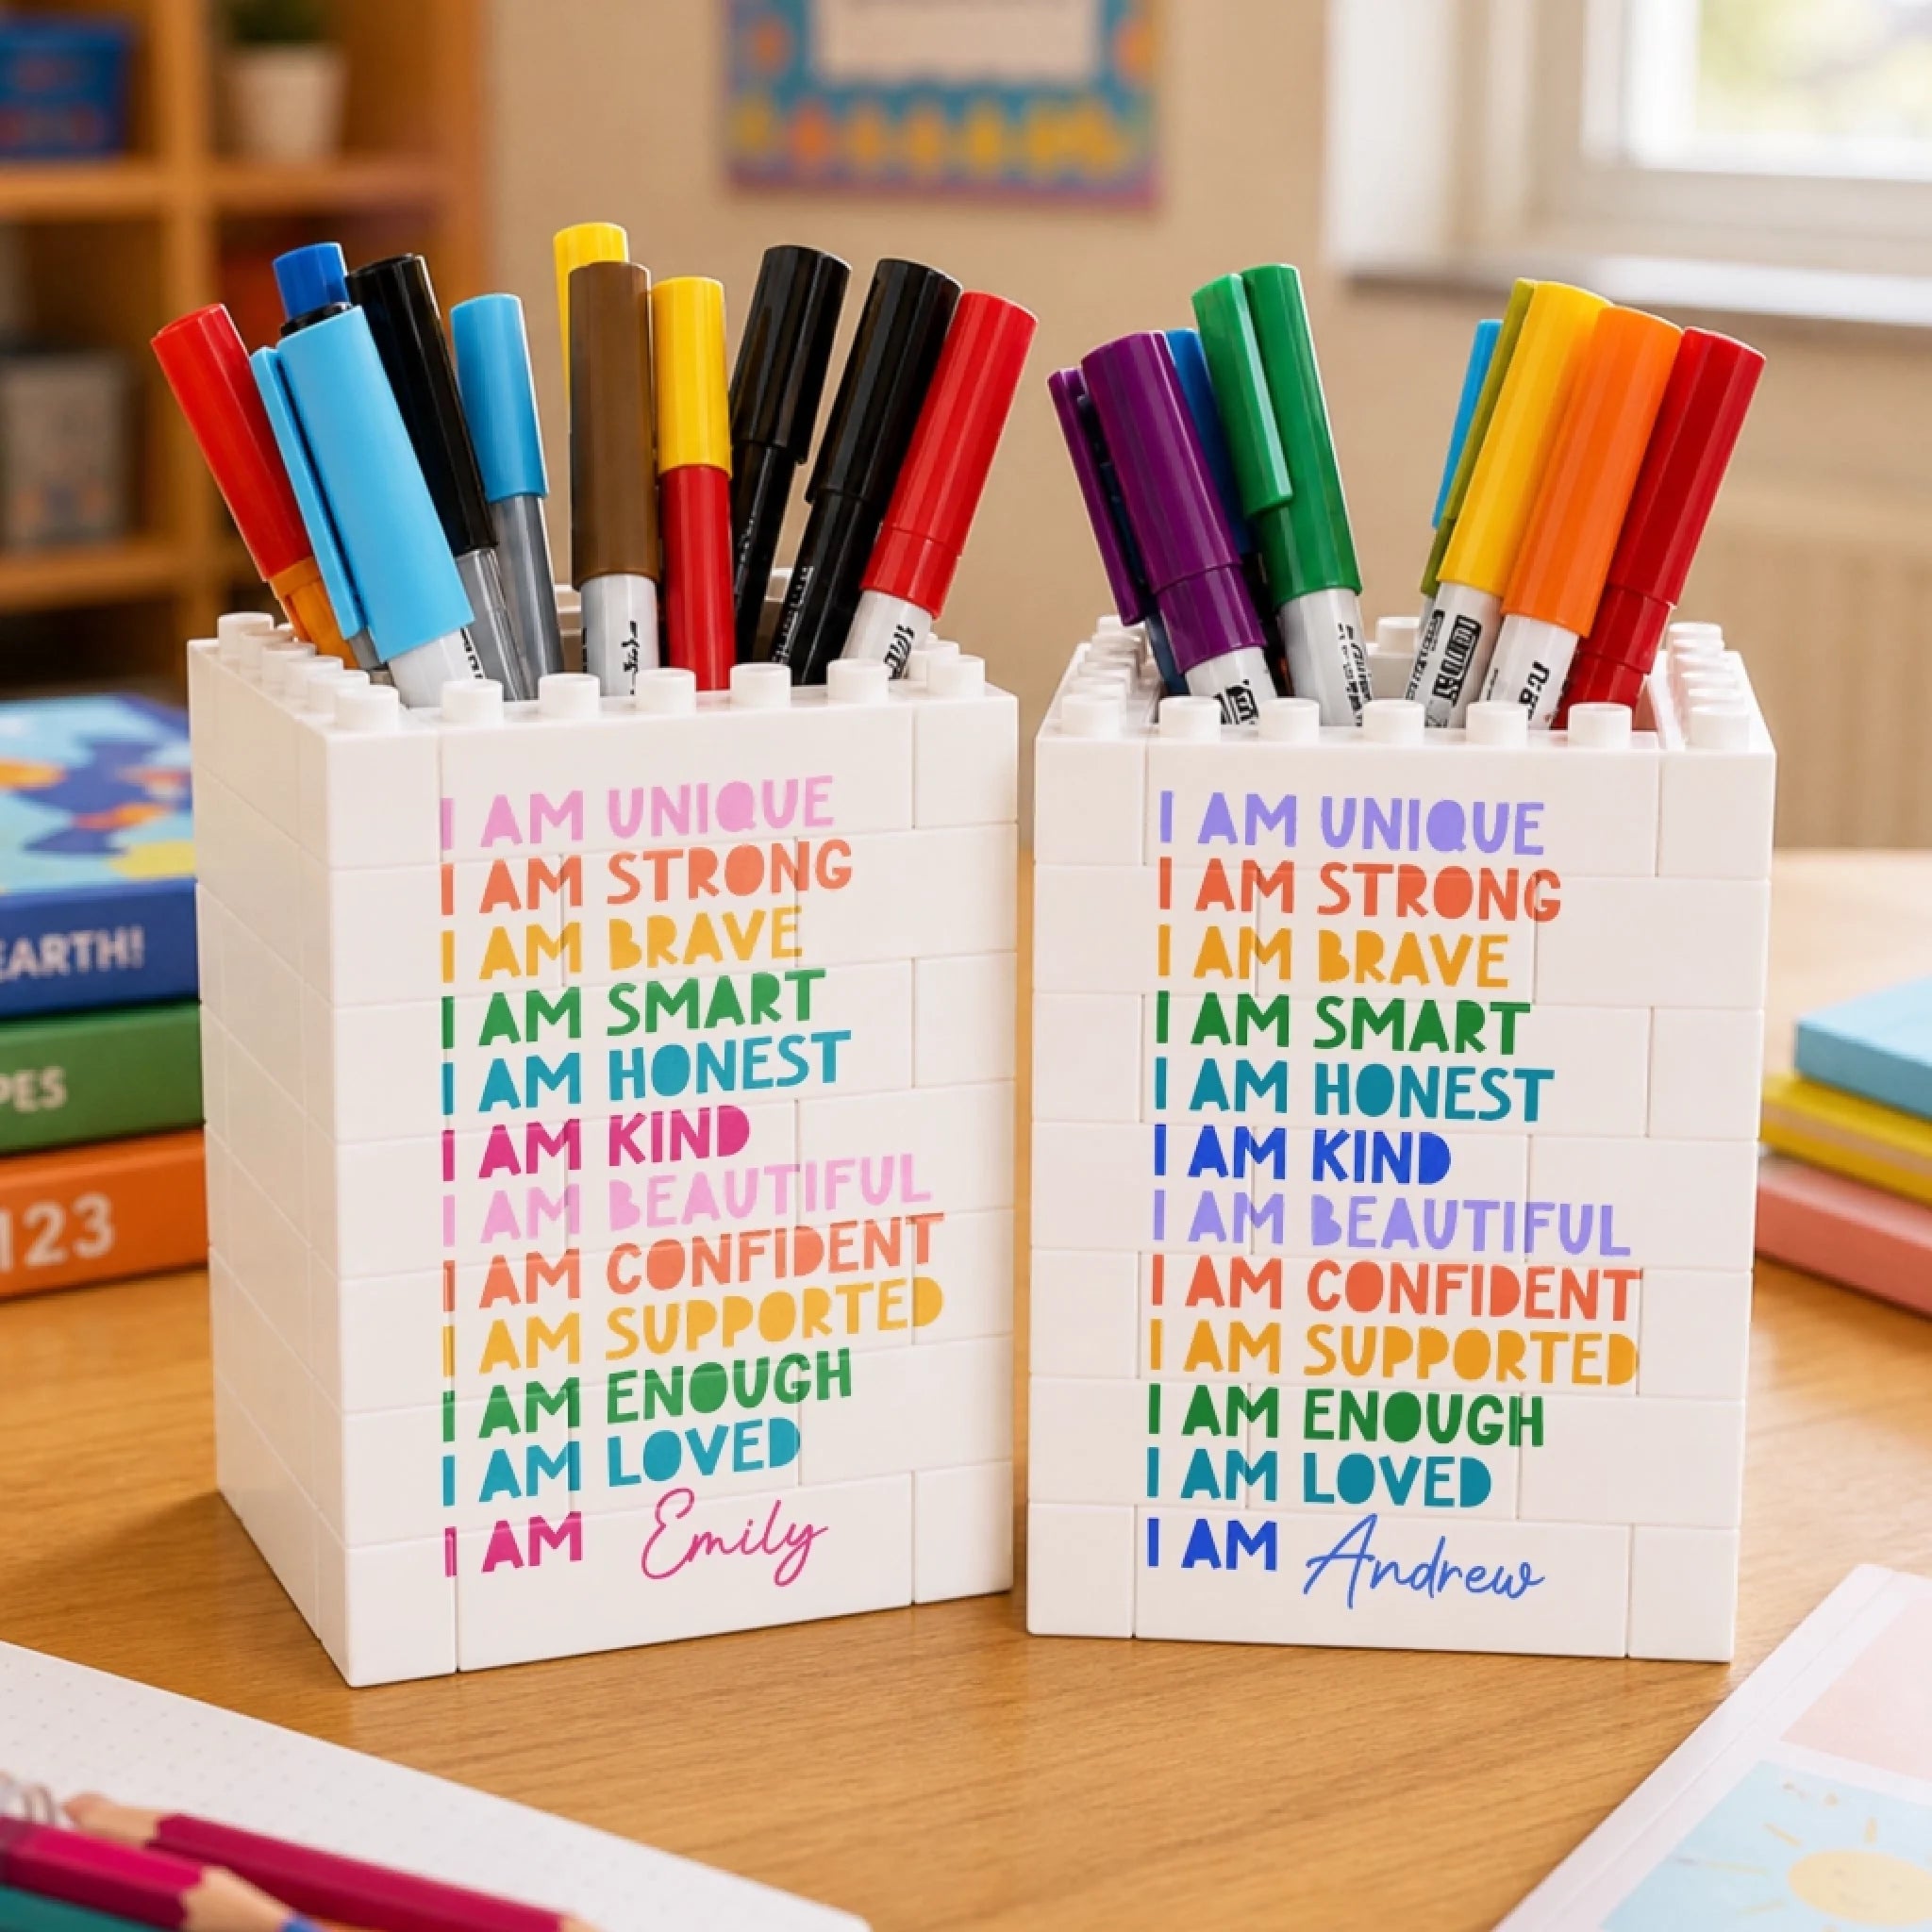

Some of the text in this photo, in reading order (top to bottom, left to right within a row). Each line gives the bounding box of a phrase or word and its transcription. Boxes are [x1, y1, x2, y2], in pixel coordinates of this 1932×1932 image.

[440, 774, 835, 851] I AM UNIQUE
[1158, 789, 1546, 858] I AM UNIQUE
[440, 838, 853, 918] I AM STRONG
[1158, 856, 1562, 924] I AM STRONG
[439, 904, 805, 985] I AM BRAVE
[1156, 922, 1511, 991] I AM BRAVE
[440, 967, 828, 1051] I AM SMART
[1155, 989, 1533, 1058] I AM SMART
[440, 1028, 853, 1117] I AM HONEST
[1153, 1056, 1556, 1124] I AM HONEST
[440, 1103, 752, 1184] I AM KIND
[1152, 1121, 1454, 1188] I AM KIND
[441, 1153, 932, 1247] I AM BEAUTIFUL
[1152, 1187, 1632, 1258] I AM BEAUTIFUL
[442, 1211, 945, 1313] I AM CONFIDENT
[1150, 1252, 1644, 1323] I AM CONFIDENT
[440, 1274, 945, 1379] I AM SUPPORTED
[1148, 1316, 1641, 1388] I AM SUPPORTED
[440, 1346, 853, 1444] I AM ENOUGH
[1146, 1381, 1545, 1449] I AM ENOUGH
[441, 1416, 802, 1508] I AM LOVED
[1145, 1444, 1493, 1509] I AM LOVED
[441, 1485, 828, 1589] I AM Emily
[1145, 1511, 1545, 1609] I AM Andrew
